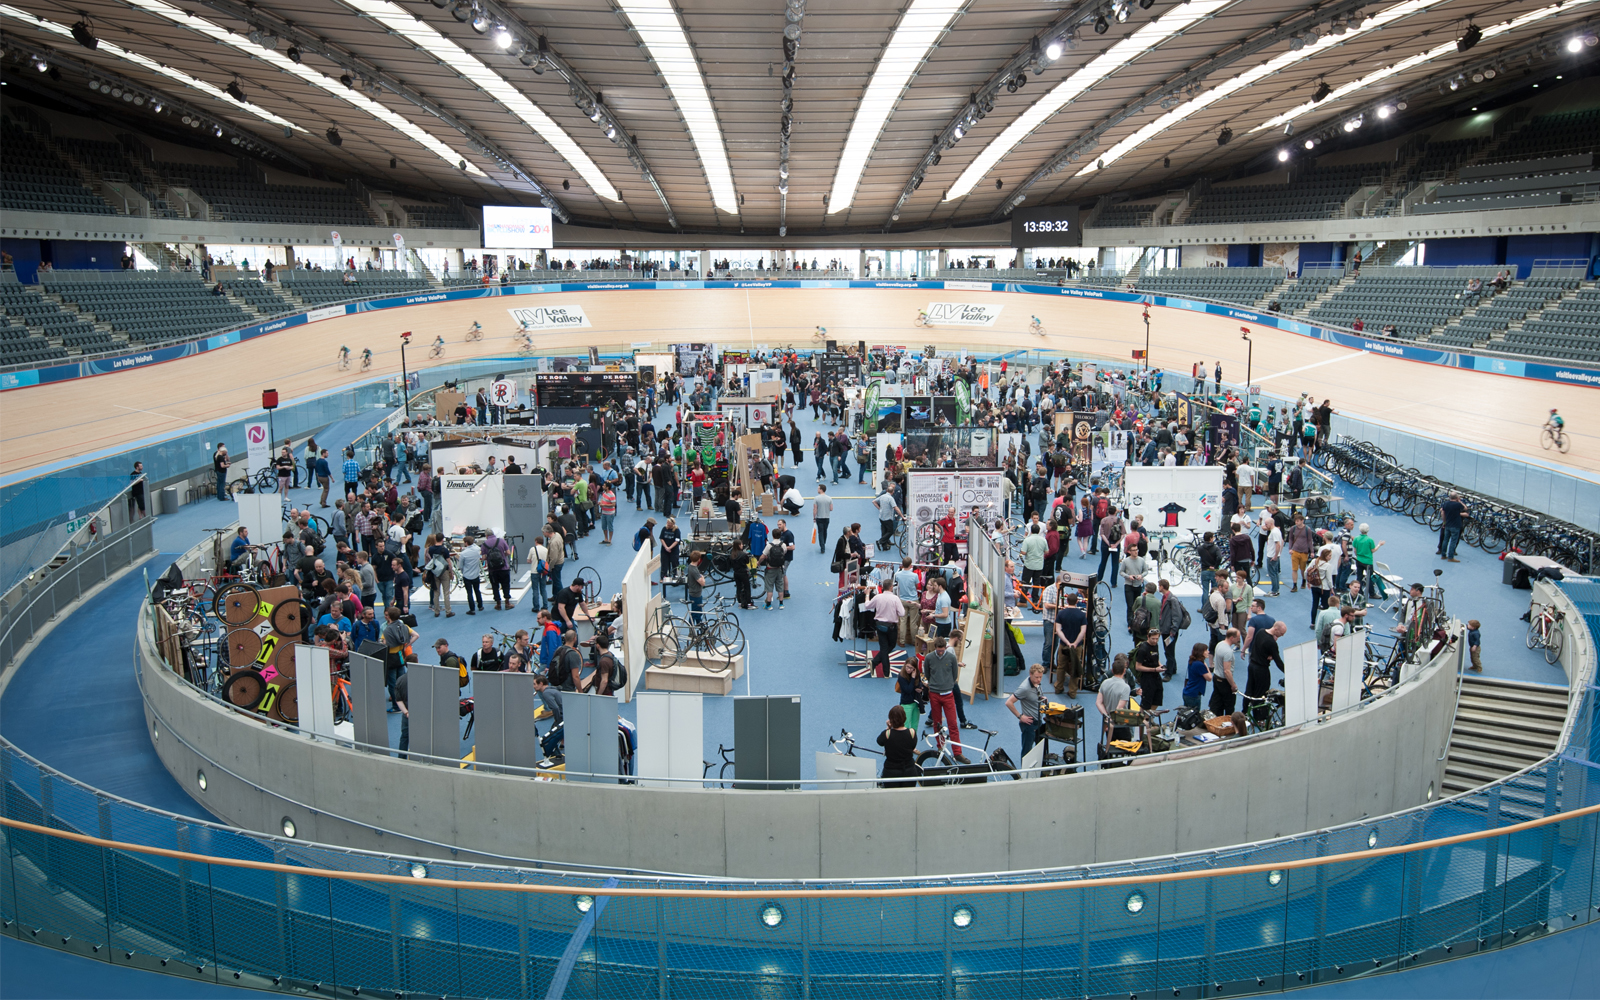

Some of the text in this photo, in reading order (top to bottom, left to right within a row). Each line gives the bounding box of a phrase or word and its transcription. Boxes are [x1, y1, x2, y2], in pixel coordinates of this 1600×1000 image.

[529, 225, 550, 234] 2014
[1023, 220, 1068, 232] 13:59:32
[548, 315, 582, 323] Valley
[960, 313, 994, 322] Valley
[1373, 343, 1384, 352] Valley
[1385, 345, 1403, 355] VeloPark
[122, 358, 135, 366] Valley
[135, 354, 153, 363] VeloPark
